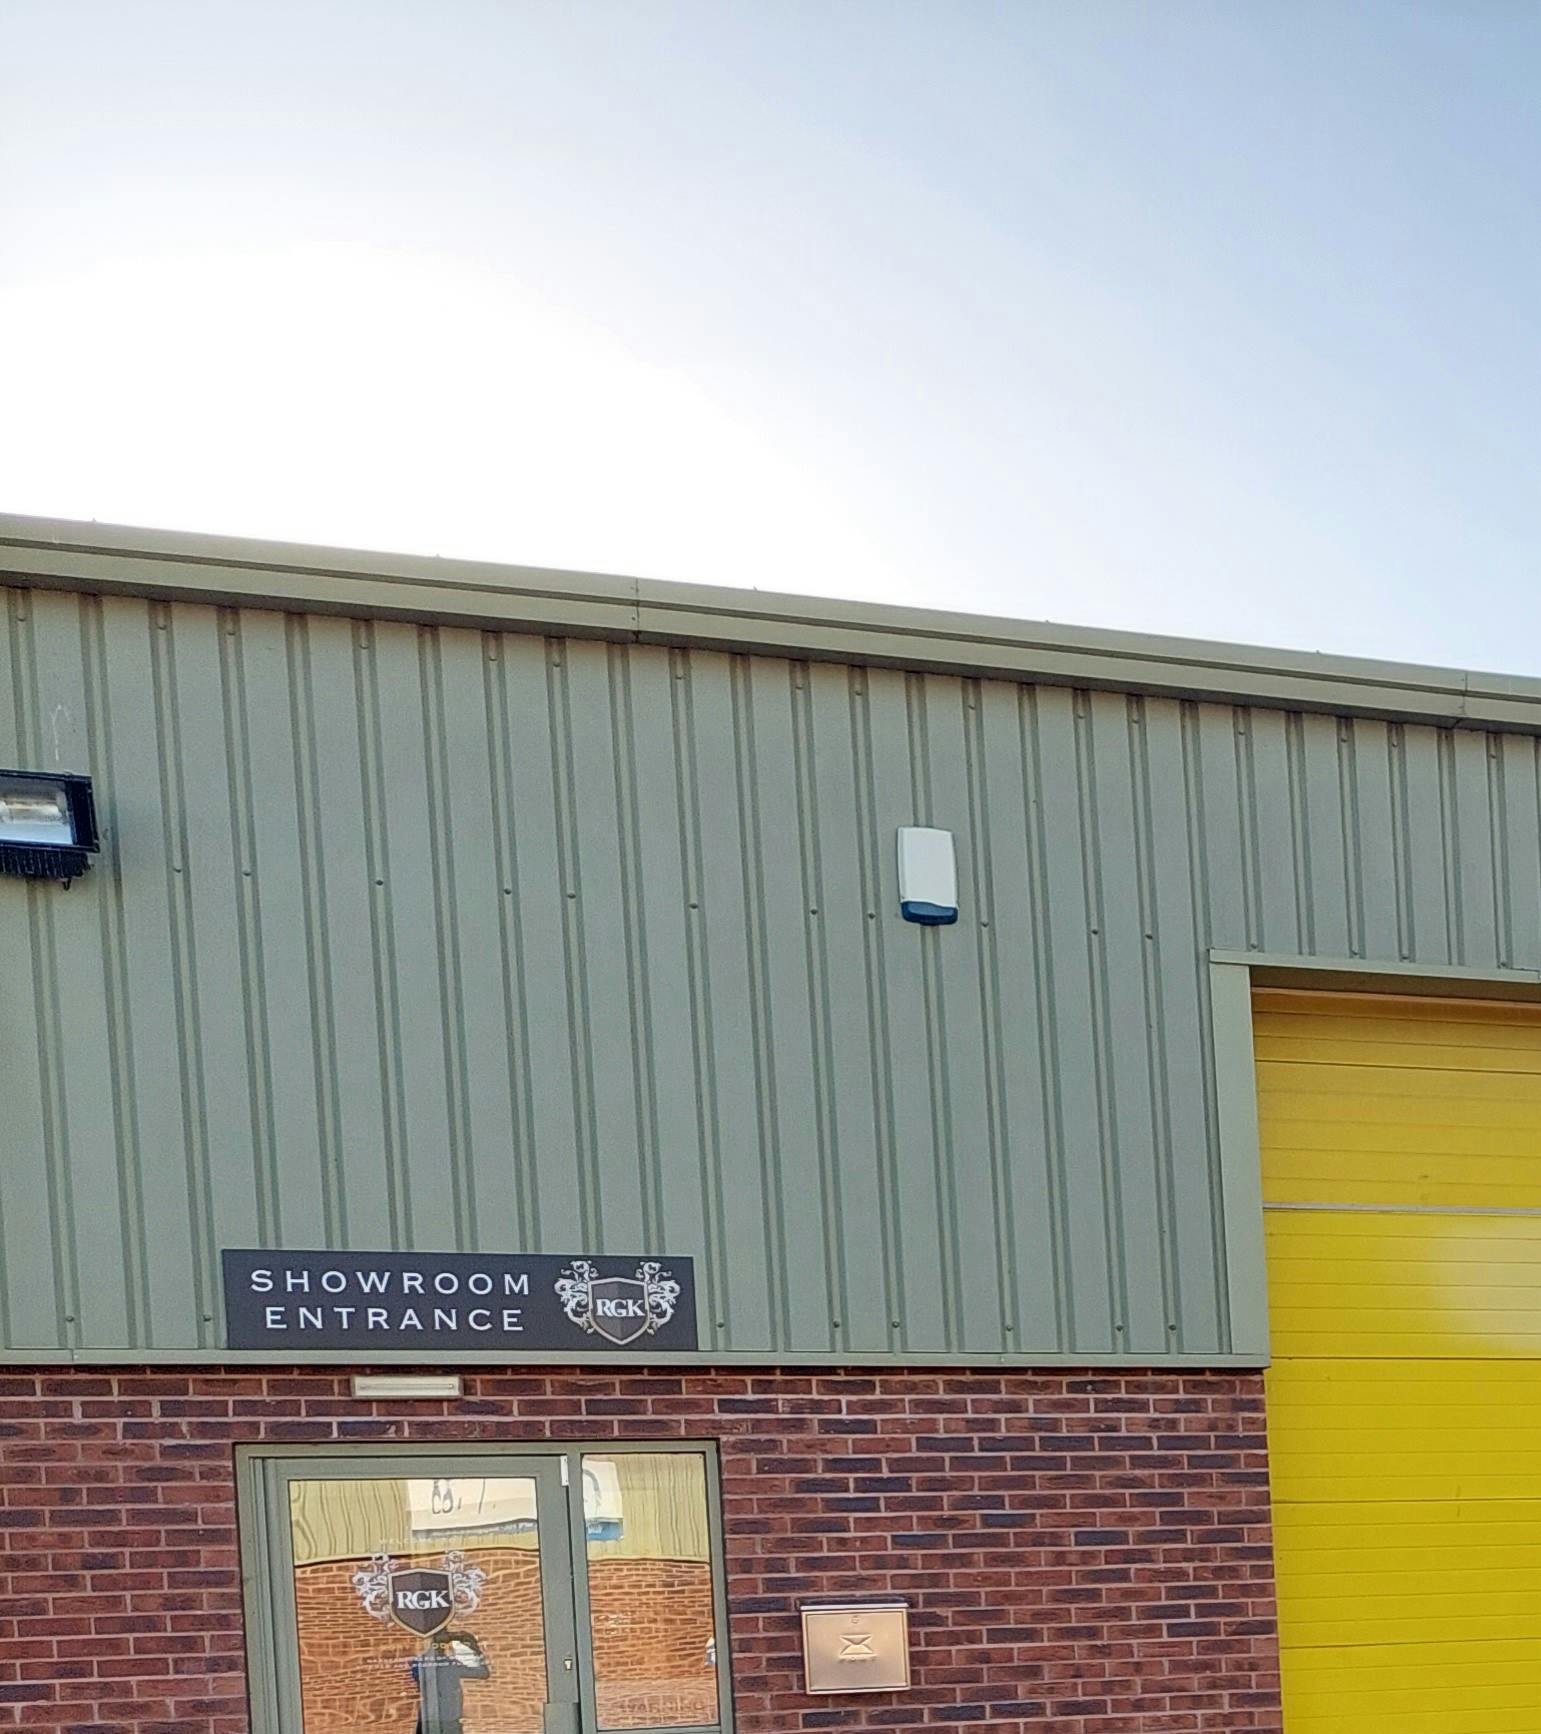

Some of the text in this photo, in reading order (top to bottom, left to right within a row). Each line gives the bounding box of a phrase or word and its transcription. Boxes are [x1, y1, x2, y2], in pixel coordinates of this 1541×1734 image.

[250, 1270, 529, 1296] SHOWROOM
[265, 1306, 524, 1332] ENTRANCE
[595, 1298, 646, 1317] RGK
[396, 1590, 450, 1610] RGK
